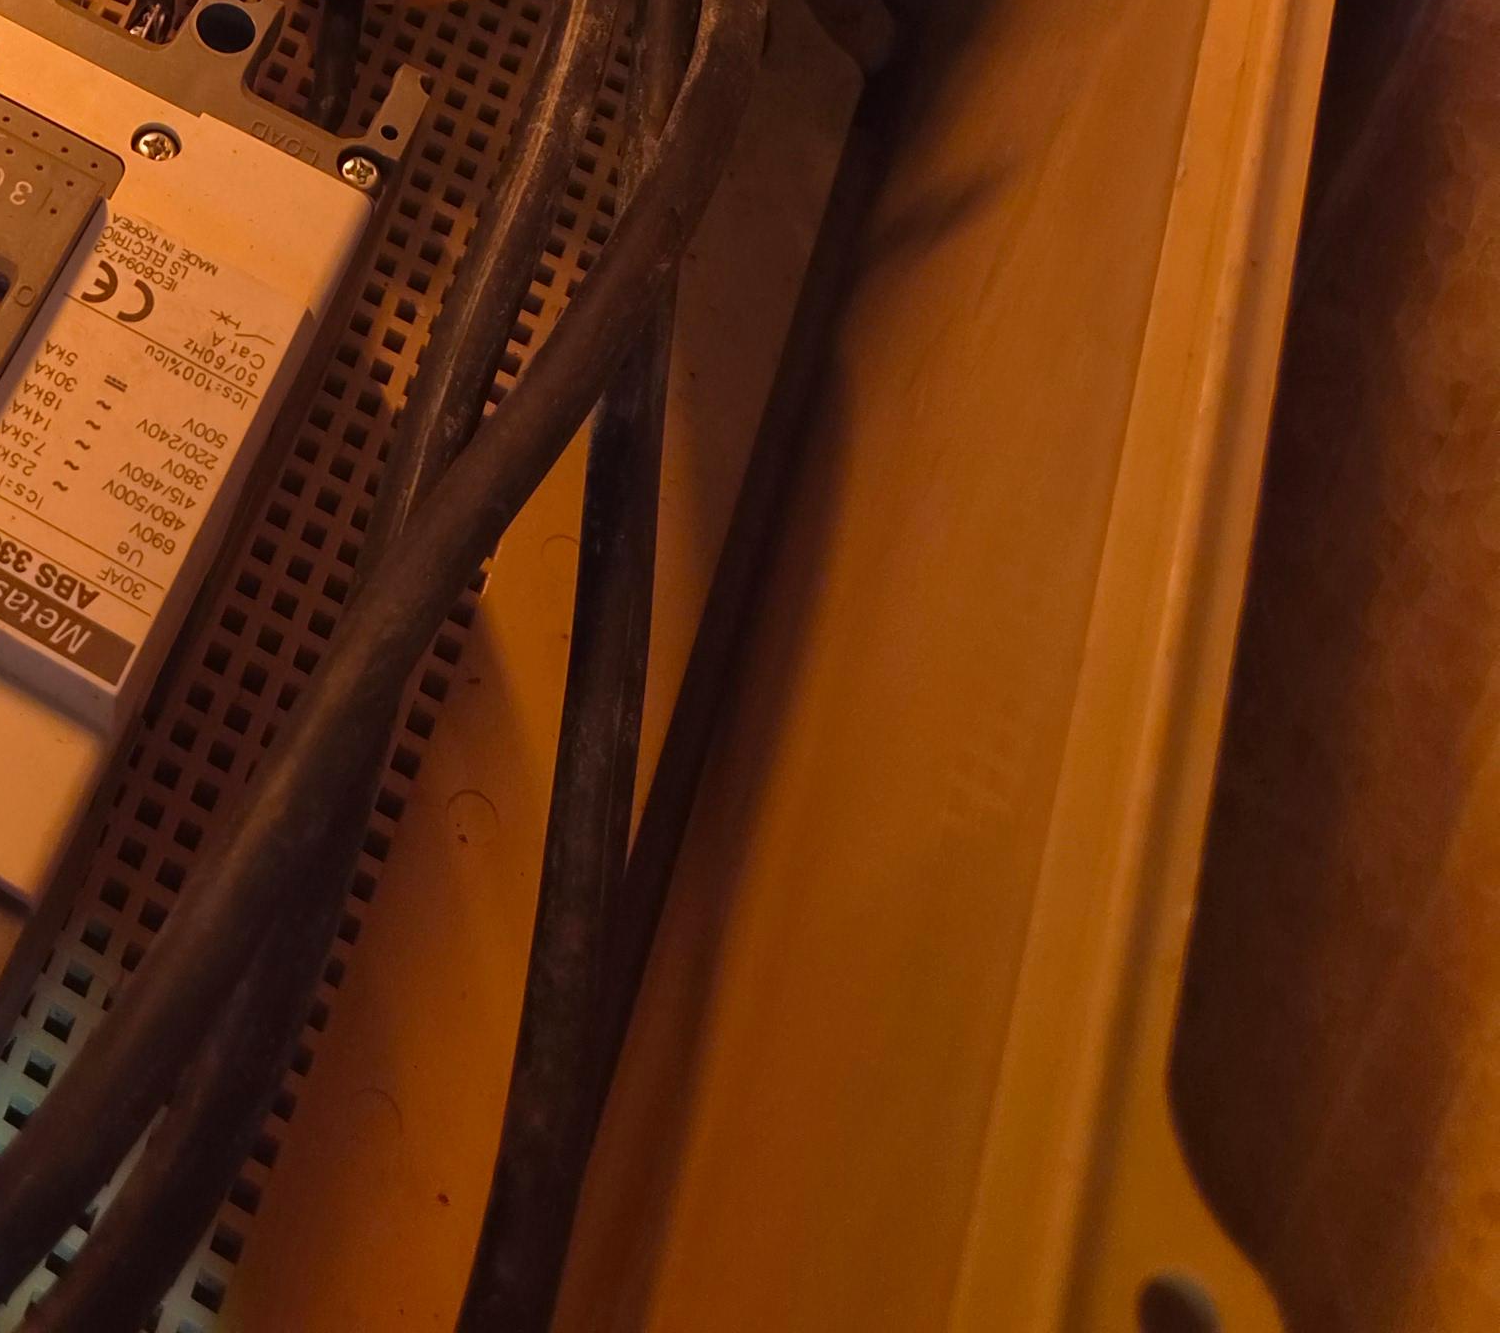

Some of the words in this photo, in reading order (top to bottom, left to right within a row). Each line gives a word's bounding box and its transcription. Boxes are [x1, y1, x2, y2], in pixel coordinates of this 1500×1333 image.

[112, 212, 159, 245] KOREA
[160, 238, 176, 253] IN
[99, 224, 169, 270] ELECTRIC
[178, 248, 219, 277] MADE
[92, 238, 179, 293] IEC60947-2
[168, 260, 190, 280] LS
[44, 339, 79, 368] 5kA
[183, 337, 259, 388] 50/60Hz
[34, 358, 78, 393] 30kA
[22, 378, 63, 412] 18kA
[11, 397, 52, 432] 14kA
[0, 418, 47, 457] 7.5kA
[135, 418, 220, 471] 220/240V
[181, 417, 229, 450] 500V
[118, 461, 197, 510] 415/460V
[160, 458, 209, 492] 380V
[101, 479, 187, 532] 480/500V
[116, 540, 145, 568] Ue
[128, 521, 177, 556] 690V
[34, 562, 101, 610] ABS
[96, 566, 147, 601] 30AF
